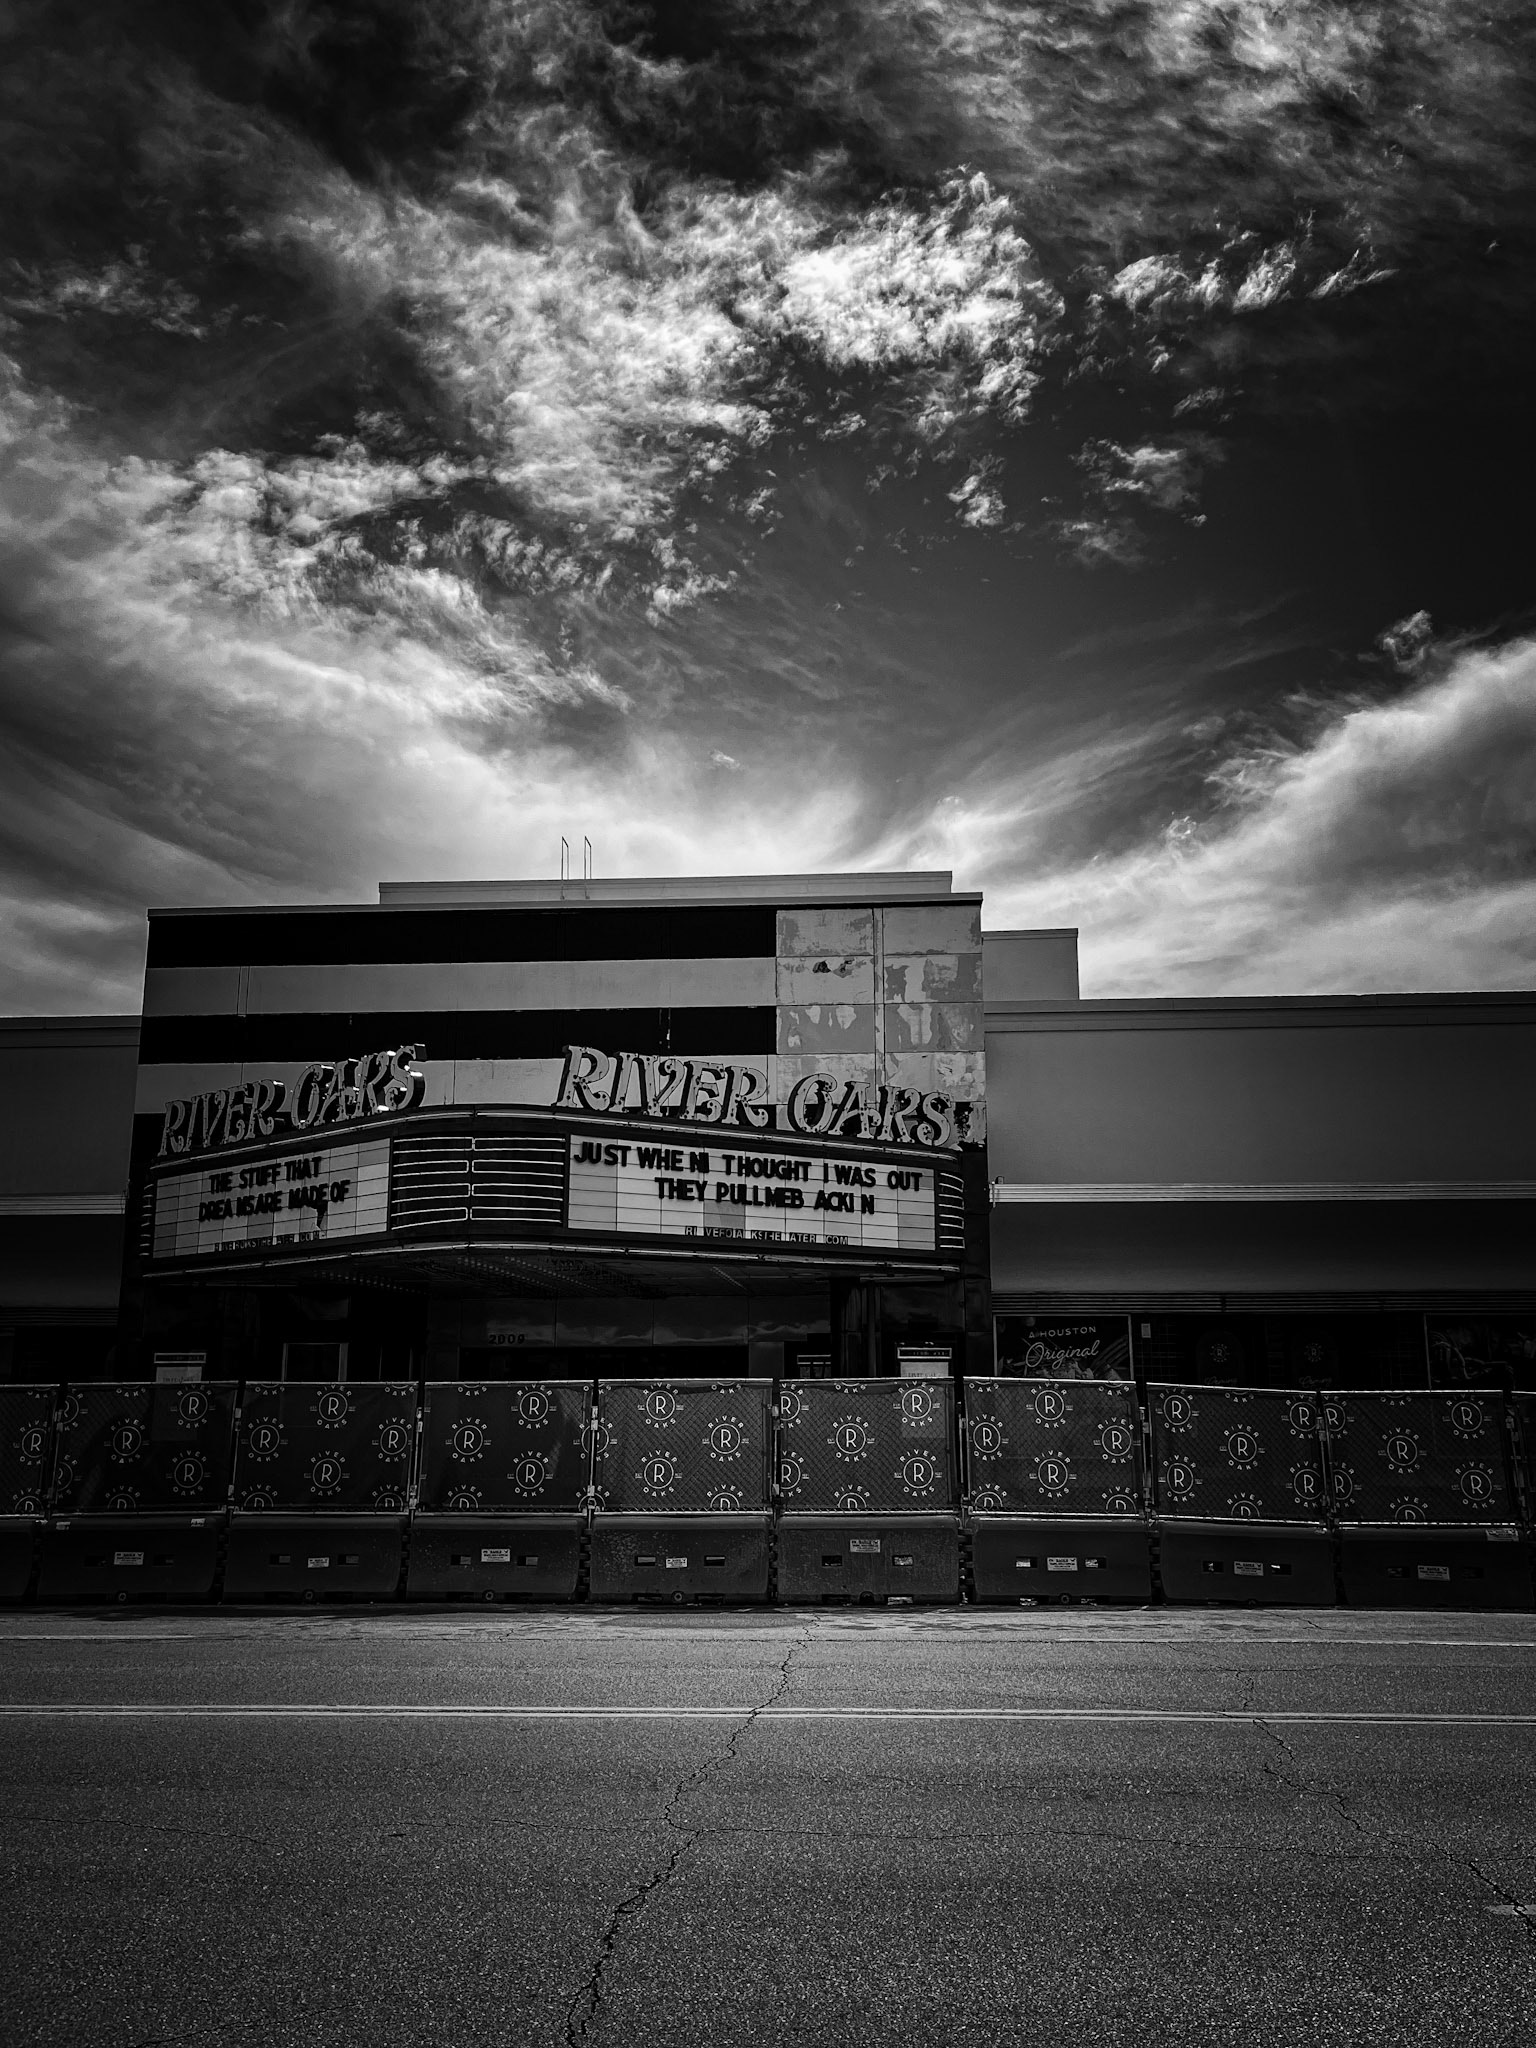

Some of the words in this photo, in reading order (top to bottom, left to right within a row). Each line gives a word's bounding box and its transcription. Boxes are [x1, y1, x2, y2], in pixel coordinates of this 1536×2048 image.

[157, 1079, 278, 1156] RIVER
[292, 1044, 424, 1129] OAKS
[557, 1045, 769, 1127] RIVER
[788, 1073, 952, 1147] OAKS
[574, 1142, 631, 1166] JUST
[721, 1154, 812, 1182] THOUGHT
[824, 1163, 828, 1183] I
[835, 1165, 876, 1187] WAS
[888, 1171, 922, 1191] OUT
[210, 1172, 233, 1194] THE
[239, 1163, 281, 1189] STUFF
[285, 1156, 321, 1181] THAT
[289, 1184, 327, 1209] MADE
[331, 1180, 350, 1202] OF
[655, 1177, 708, 1201] THEY
[1040, 1326, 1096, 1337] HOUSTON
[1026, 1340, 1100, 1369] Original
[255, 1386, 285, 1396] OAKS
[317, 1384, 352, 1397] RIVER
[385, 1387, 415, 1396] OAKS
[458, 1386, 487, 1396] OAKS
[517, 1384, 552, 1396] RIVER
[583, 1385, 611, 1395] OKS
[643, 1382, 678, 1395] RIVER
[711, 1384, 742, 1394] OAKS
[781, 1384, 803, 1395] VER
[835, 1384, 867, 1393] OAKS
[898, 1381, 934, 1393] RIVER
[969, 1383, 999, 1392] OAKS
[1031, 1382, 1067, 1395] RIVER
[1098, 1386, 1130, 1396] OAKS
[189, 1397, 199, 1414] R
[328, 1397, 339, 1415] R
[529, 1397, 540, 1415] R
[656, 1396, 666, 1414] R
[781, 1396, 791, 1414] R
[912, 1394, 922, 1412] R
[1045, 1396, 1056, 1414] R
[1172, 1401, 1182, 1419] R
[1299, 1407, 1310, 1425] R
[1326, 1408, 1338, 1425] R
[1461, 1407, 1472, 1425] R
[178, 1419, 207, 1429] OAKS
[248, 1417, 284, 1429] RIVER
[317, 1419, 347, 1429] OAKS
[379, 1417, 412, 1430] RIVER
[452, 1418, 487, 1430] RIVER
[518, 1419, 548, 1429] OAKS
[579, 1418, 613, 1429] RIER
[646, 1418, 676, 1428] OAKS
[708, 1416, 744, 1428] RIVER
[833, 1416, 868, 1428] RIVER
[902, 1417, 933, 1427] OAKS
[969, 1414, 1003, 1428] RIVER
[1035, 1418, 1066, 1428] OAKS
[1098, 1417, 1134, 1430] RIVER
[1164, 1423, 1192, 1433] OAKS
[1223, 1424, 1259, 1438] RIVER
[1290, 1429, 1314, 1439] OAK
[1329, 1429, 1348, 1439] AKS
[1382, 1427, 1419, 1440] RIVER
[1453, 1429, 1485, 1439] OAKS
[31, 1434, 41, 1451] R
[122, 1432, 132, 1449] R
[260, 1430, 271, 1448] R
[388, 1431, 399, 1448] R
[463, 1431, 474, 1449] R
[721, 1429, 731, 1447] R
[846, 1429, 857, 1447] R
[983, 1428, 992, 1446] R
[1112, 1431, 1122, 1449] R
[1238, 1438, 1248, 1456] R
[1396, 1441, 1408, 1459] R
[248, 1452, 279, 1462] OAKS
[310, 1450, 346, 1463] RIVER
[378, 1453, 407, 1462] OAKS
[452, 1453, 483, 1463] OAKS
[513, 1451, 549, 1464] RIVER
[580, 1452, 609, 1462] OKS
[642, 1450, 677, 1462] RIVER
[710, 1452, 741, 1462] OAKS
[782, 1451, 804, 1463] VER
[835, 1452, 867, 1462] OAKS
[900, 1449, 936, 1462] RIVER
[974, 1451, 1002, 1461] OAKS
[1034, 1450, 1071, 1463] RIVER
[1102, 1454, 1133, 1464] OAKS
[1228, 1460, 1258, 1470] OAKS
[1389, 1464, 1420, 1474] OAKS
[1455, 1461, 1493, 1474] RIVER
[184, 1464, 194, 1481] R
[321, 1464, 332, 1482] R
[525, 1464, 536, 1483] R
[654, 1464, 664, 1482] R
[781, 1464, 792, 1483] R
[913, 1463, 924, 1482] R
[1048, 1464, 1059, 1483] R
[1174, 1469, 1184, 1487] R
[242, 1484, 278, 1497] RIVER
[971, 1484, 1007, 1497] RIVER
[1304, 1475, 1314, 1493] R
[1335, 1475, 1345, 1493] R
[1471, 1475, 1483, 1494] R
[310, 1486, 342, 1496] OAKS
[448, 1485, 483, 1497] RIVER
[514, 1487, 545, 1497] OAKS
[576, 1485, 610, 1498] RIER
[643, 1487, 674, 1497] OAKS
[707, 1485, 743, 1497] RIVER
[780, 1488, 802, 1497] AKS
[834, 1485, 870, 1497] RIVER
[903, 1486, 935, 1497] OAKS
[1039, 1488, 1069, 1498] OAKS
[1102, 1486, 1138, 1499] RIVER
[1167, 1491, 1195, 1502] OAKS
[1227, 1492, 1262, 1506] RIVER
[1295, 1497, 1318, 1508] OAK
[1336, 1498, 1356, 1508] AKS
[1390, 1496, 1428, 1509] RIVER
[1463, 1499, 1495, 1509] OAKS
